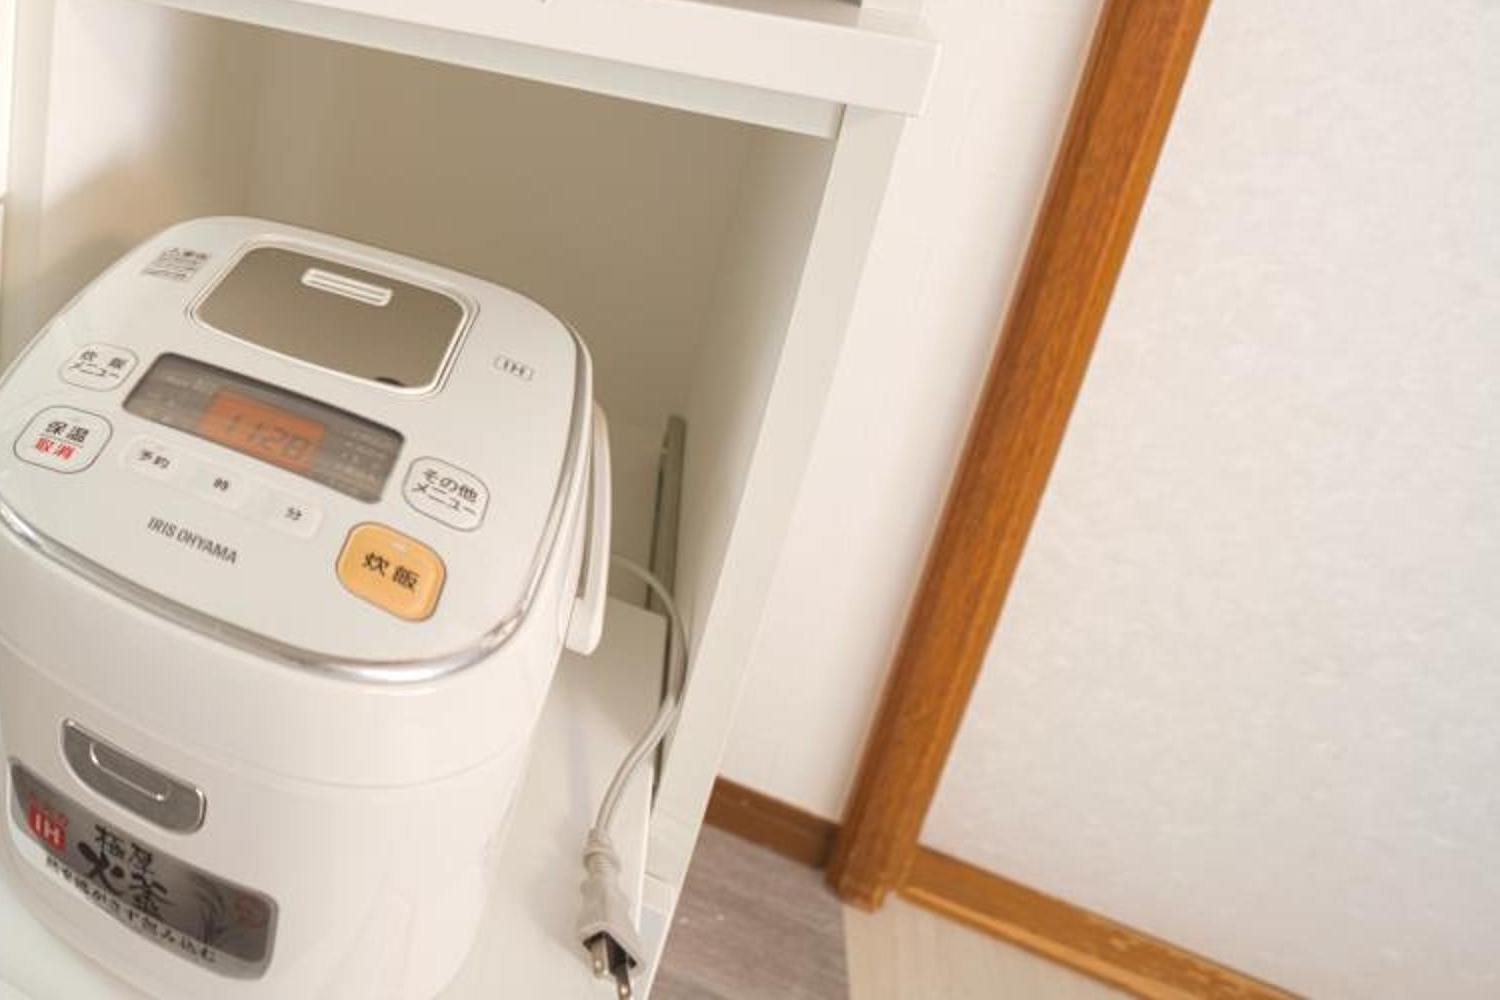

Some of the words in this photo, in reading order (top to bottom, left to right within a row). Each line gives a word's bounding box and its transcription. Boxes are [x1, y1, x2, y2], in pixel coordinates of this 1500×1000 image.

[46, 420, 89, 443] 保温
[35, 438, 77, 460] 取消
[212, 477, 230, 491] 時
[412, 482, 477, 515] メニュー
[422, 468, 479, 502] その他
[147, 516, 176, 538] IRIS
[176, 525, 238, 564] OHYAMA
[361, 551, 421, 593] 炊飯
[34, 811, 64, 846] IH
